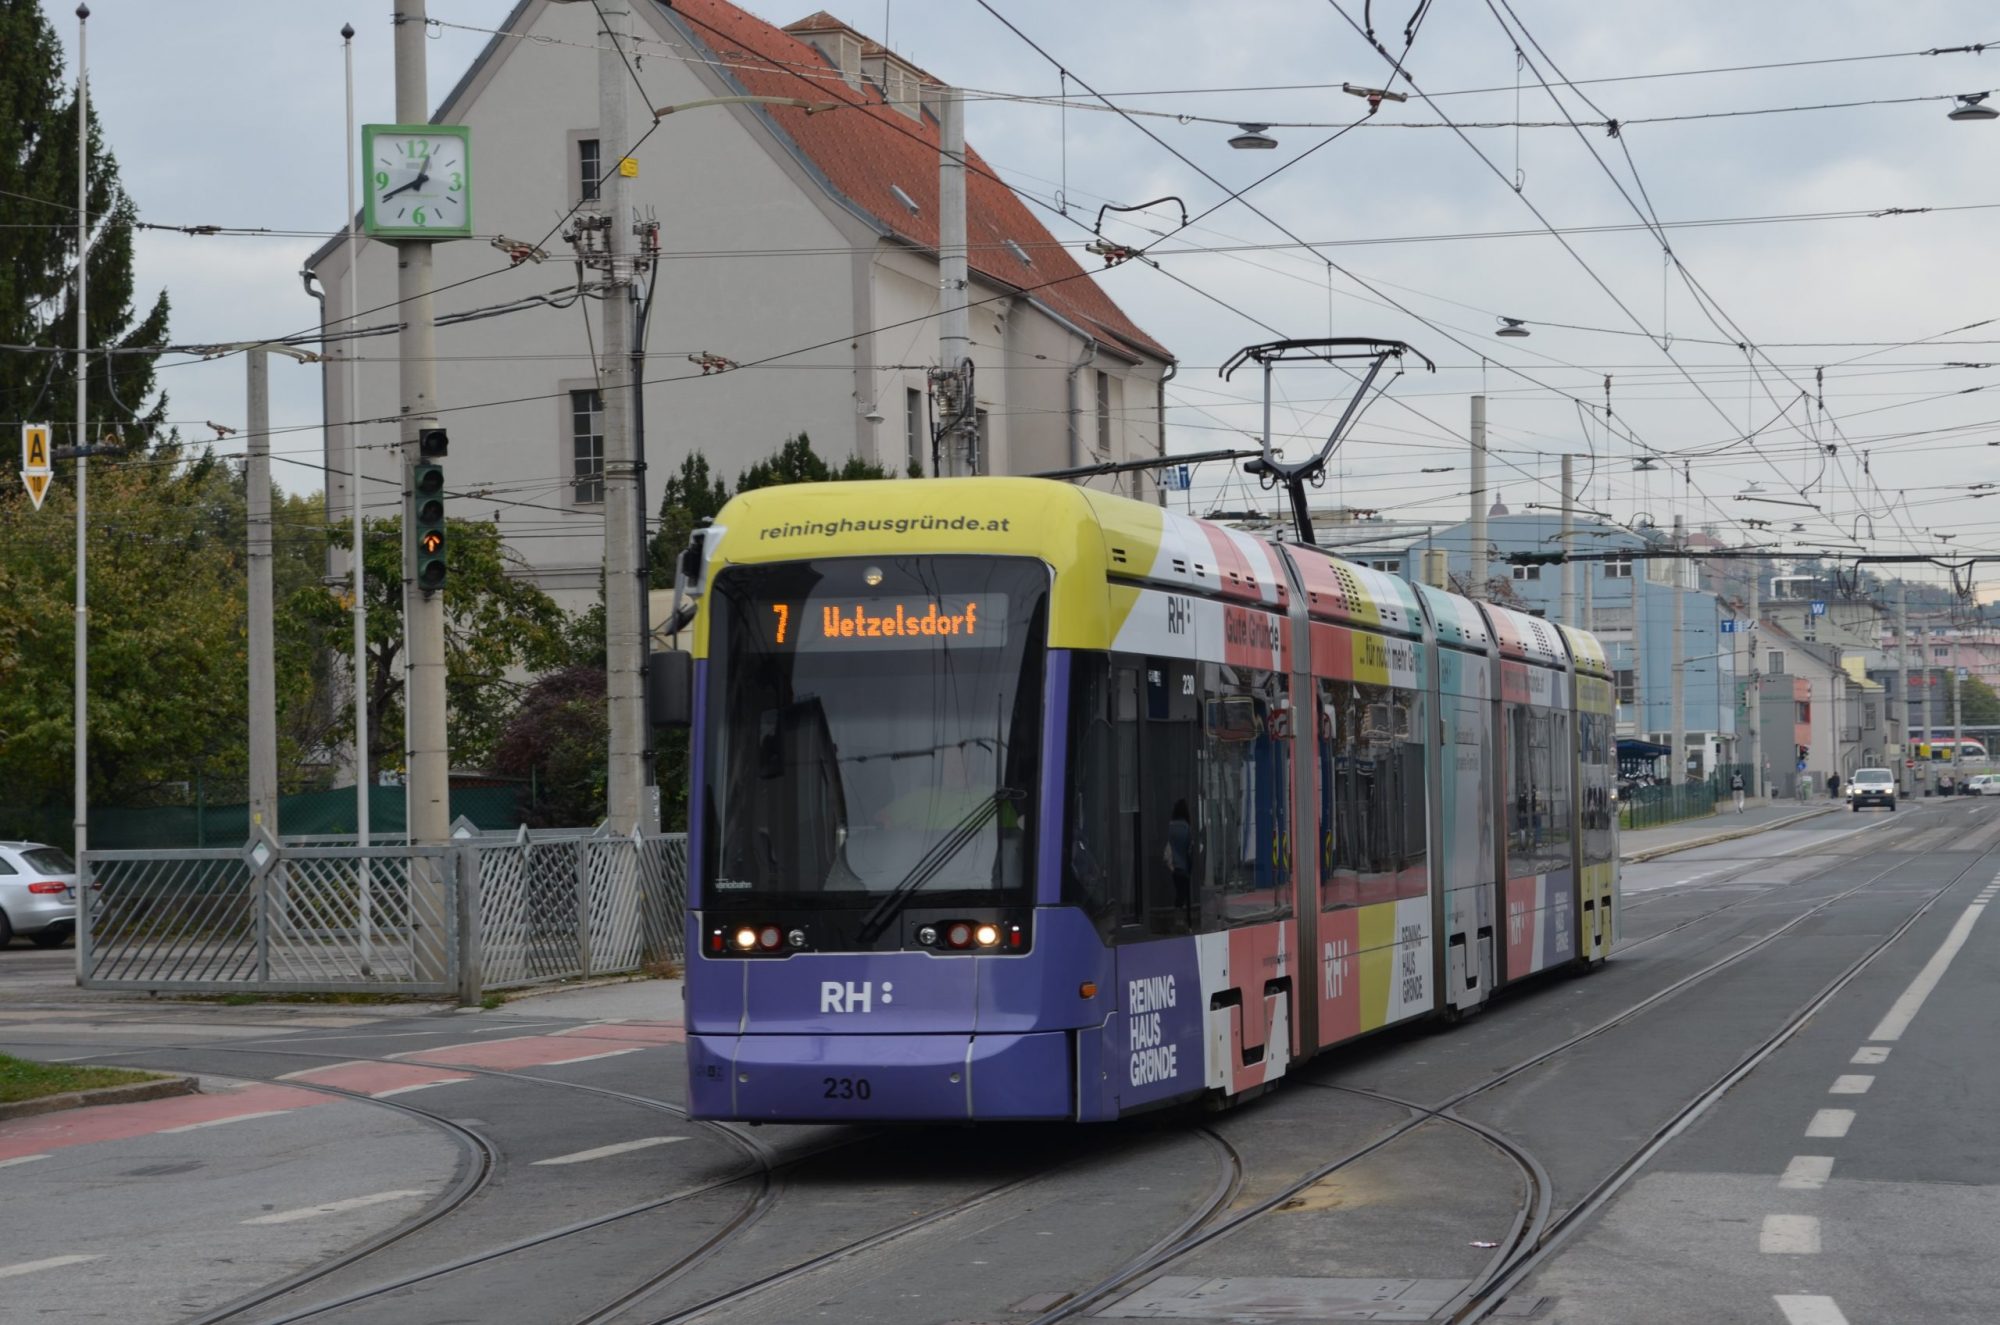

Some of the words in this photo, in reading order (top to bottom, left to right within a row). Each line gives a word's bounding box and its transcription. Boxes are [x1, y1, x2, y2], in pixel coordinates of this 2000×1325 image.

[407, 140, 429, 159] 12
[376, 172, 389, 191] 9
[449, 172, 462, 192] 3
[412, 206, 426, 225] 6
[30, 433, 44, 463] A
[760, 515, 1010, 540] reininghausgründe.at
[1811, 604, 1824, 614] W
[773, 604, 788, 643] 7
[823, 602, 976, 637] Wetzelsdorf
[1226, 608, 1247, 646] Gute
[1723, 623, 1730, 631] T
[1182, 674, 1195, 695] 230
[1129, 974, 1176, 1015] REINING
[1130, 1012, 1161, 1051] HAUS
[1130, 1044, 1177, 1087] GRÜNDE
[823, 1077, 872, 1100] 230
